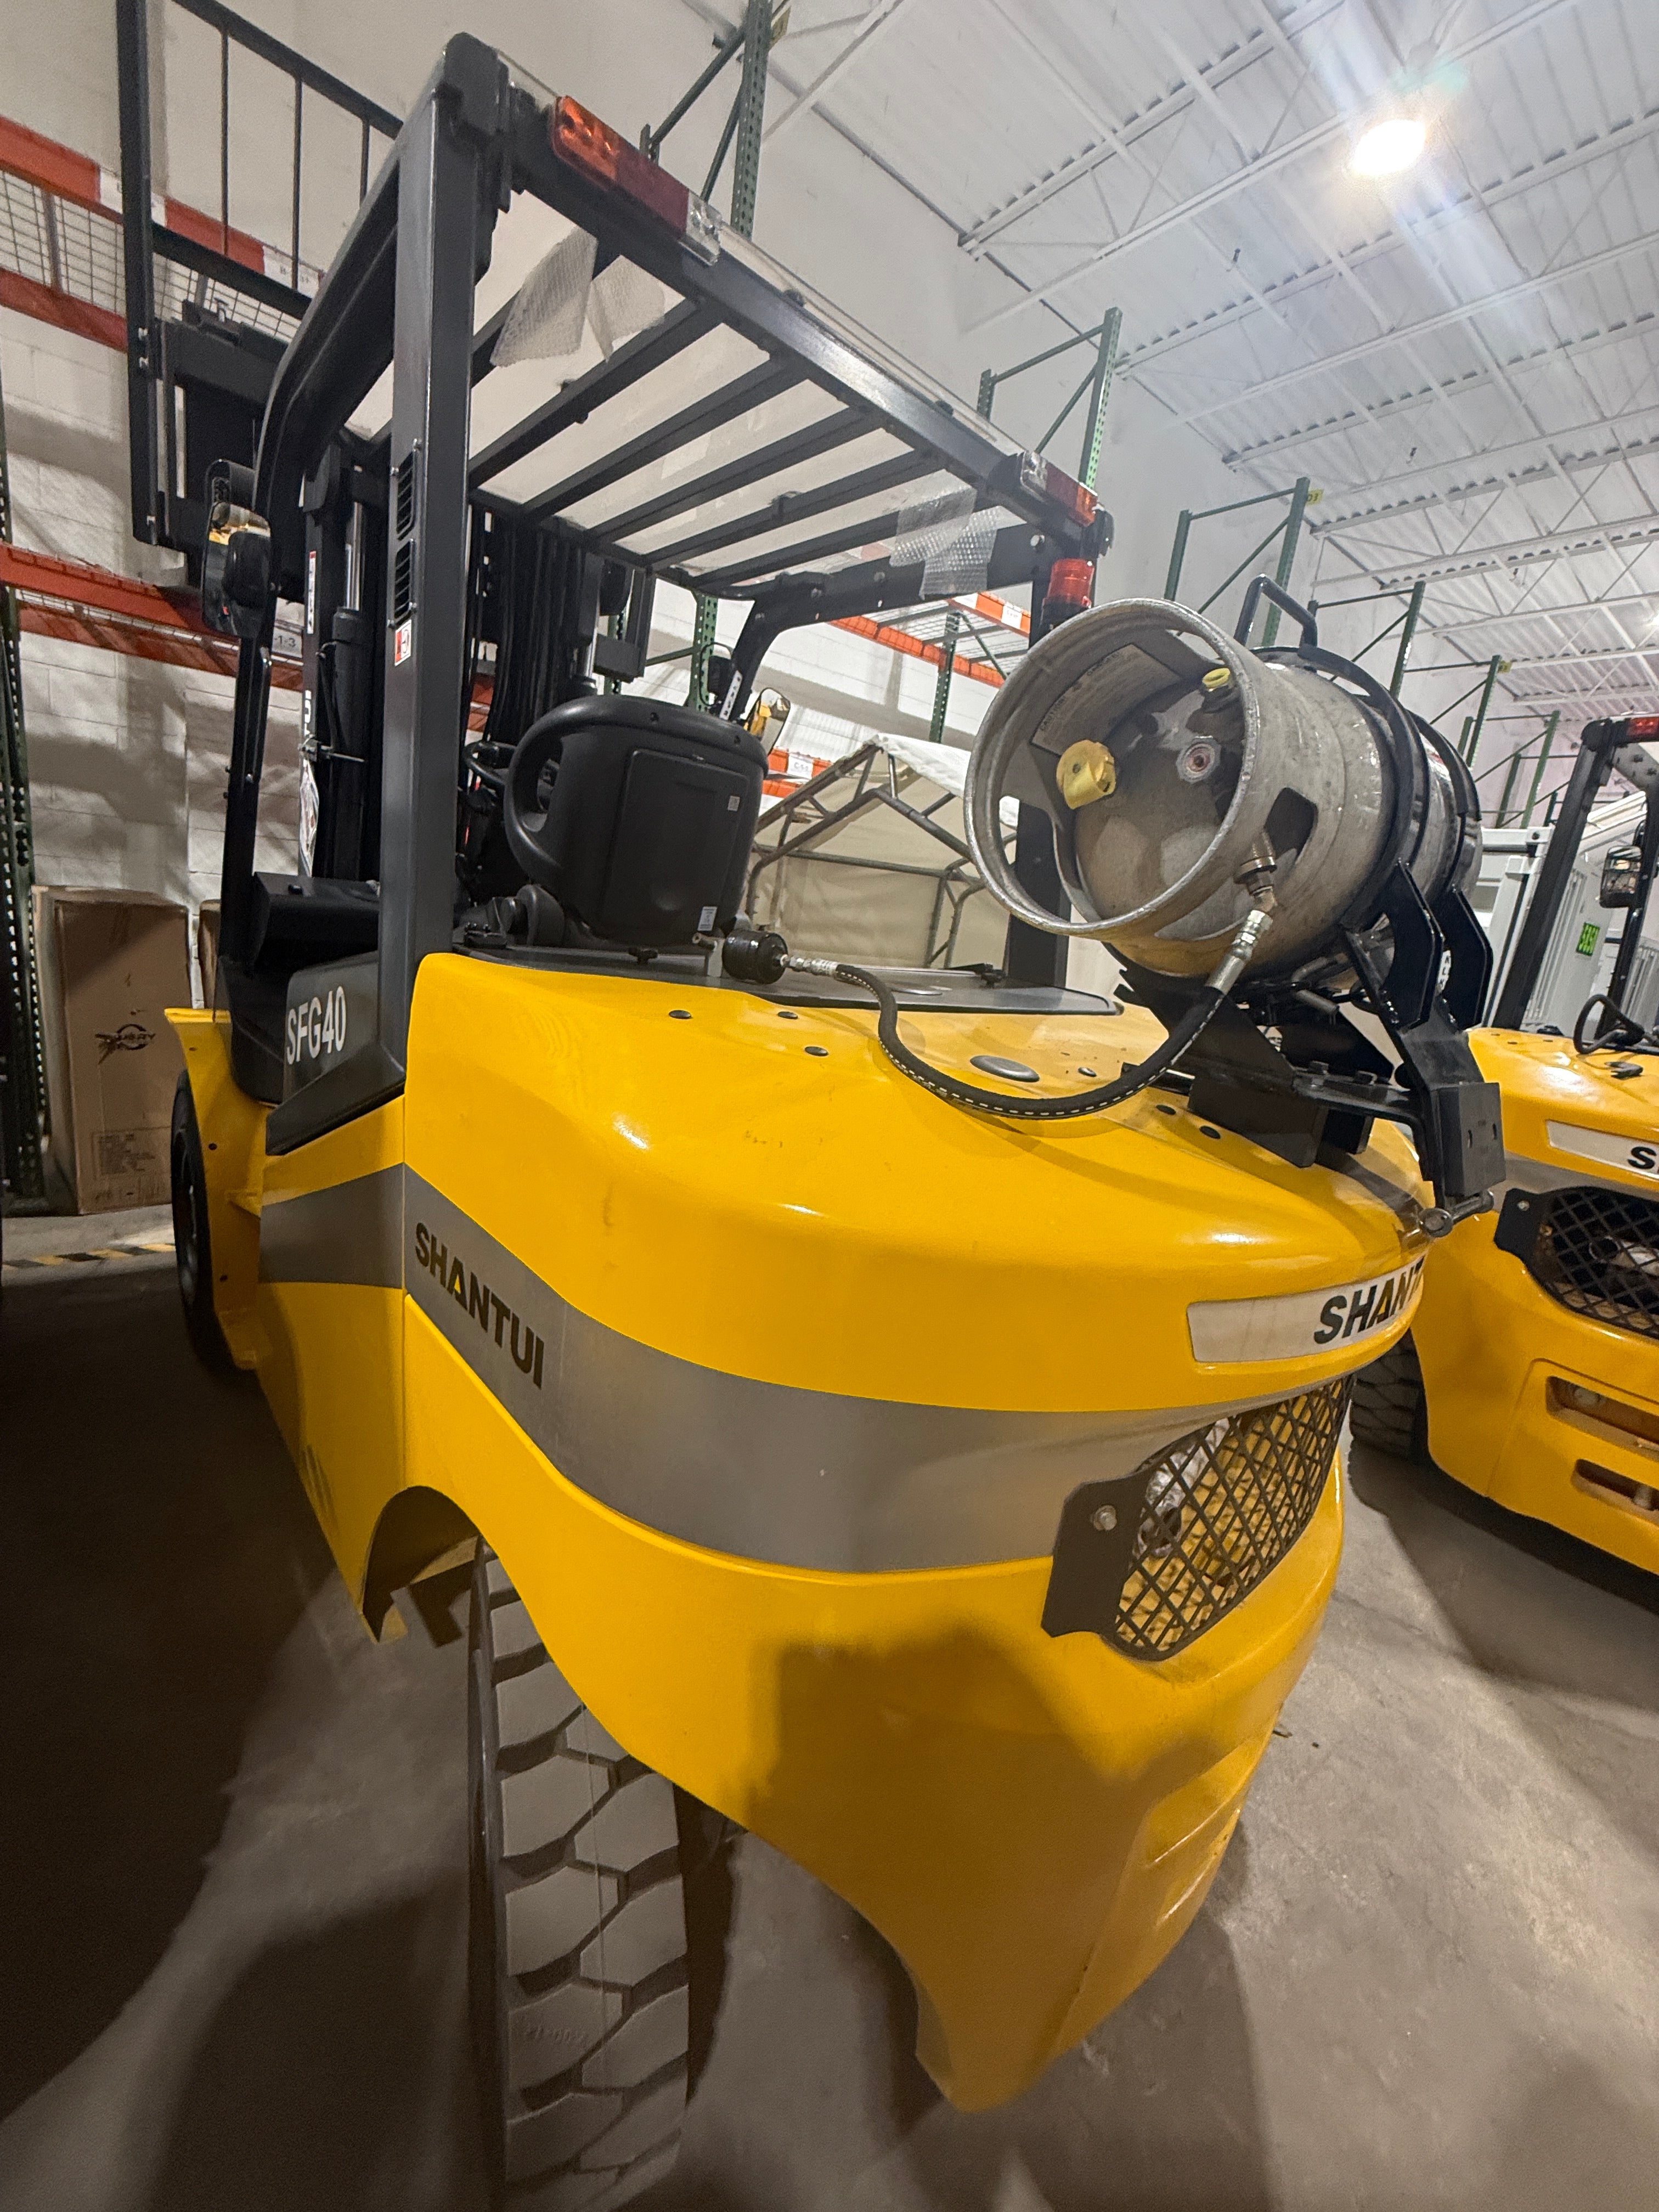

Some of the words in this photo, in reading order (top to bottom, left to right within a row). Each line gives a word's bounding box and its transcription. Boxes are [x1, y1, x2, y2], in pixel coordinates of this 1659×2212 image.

[286, 986, 346, 1065] SFG40
[1627, 1146, 1659, 1174] S
[415, 1222, 544, 1391] SHANTUI
